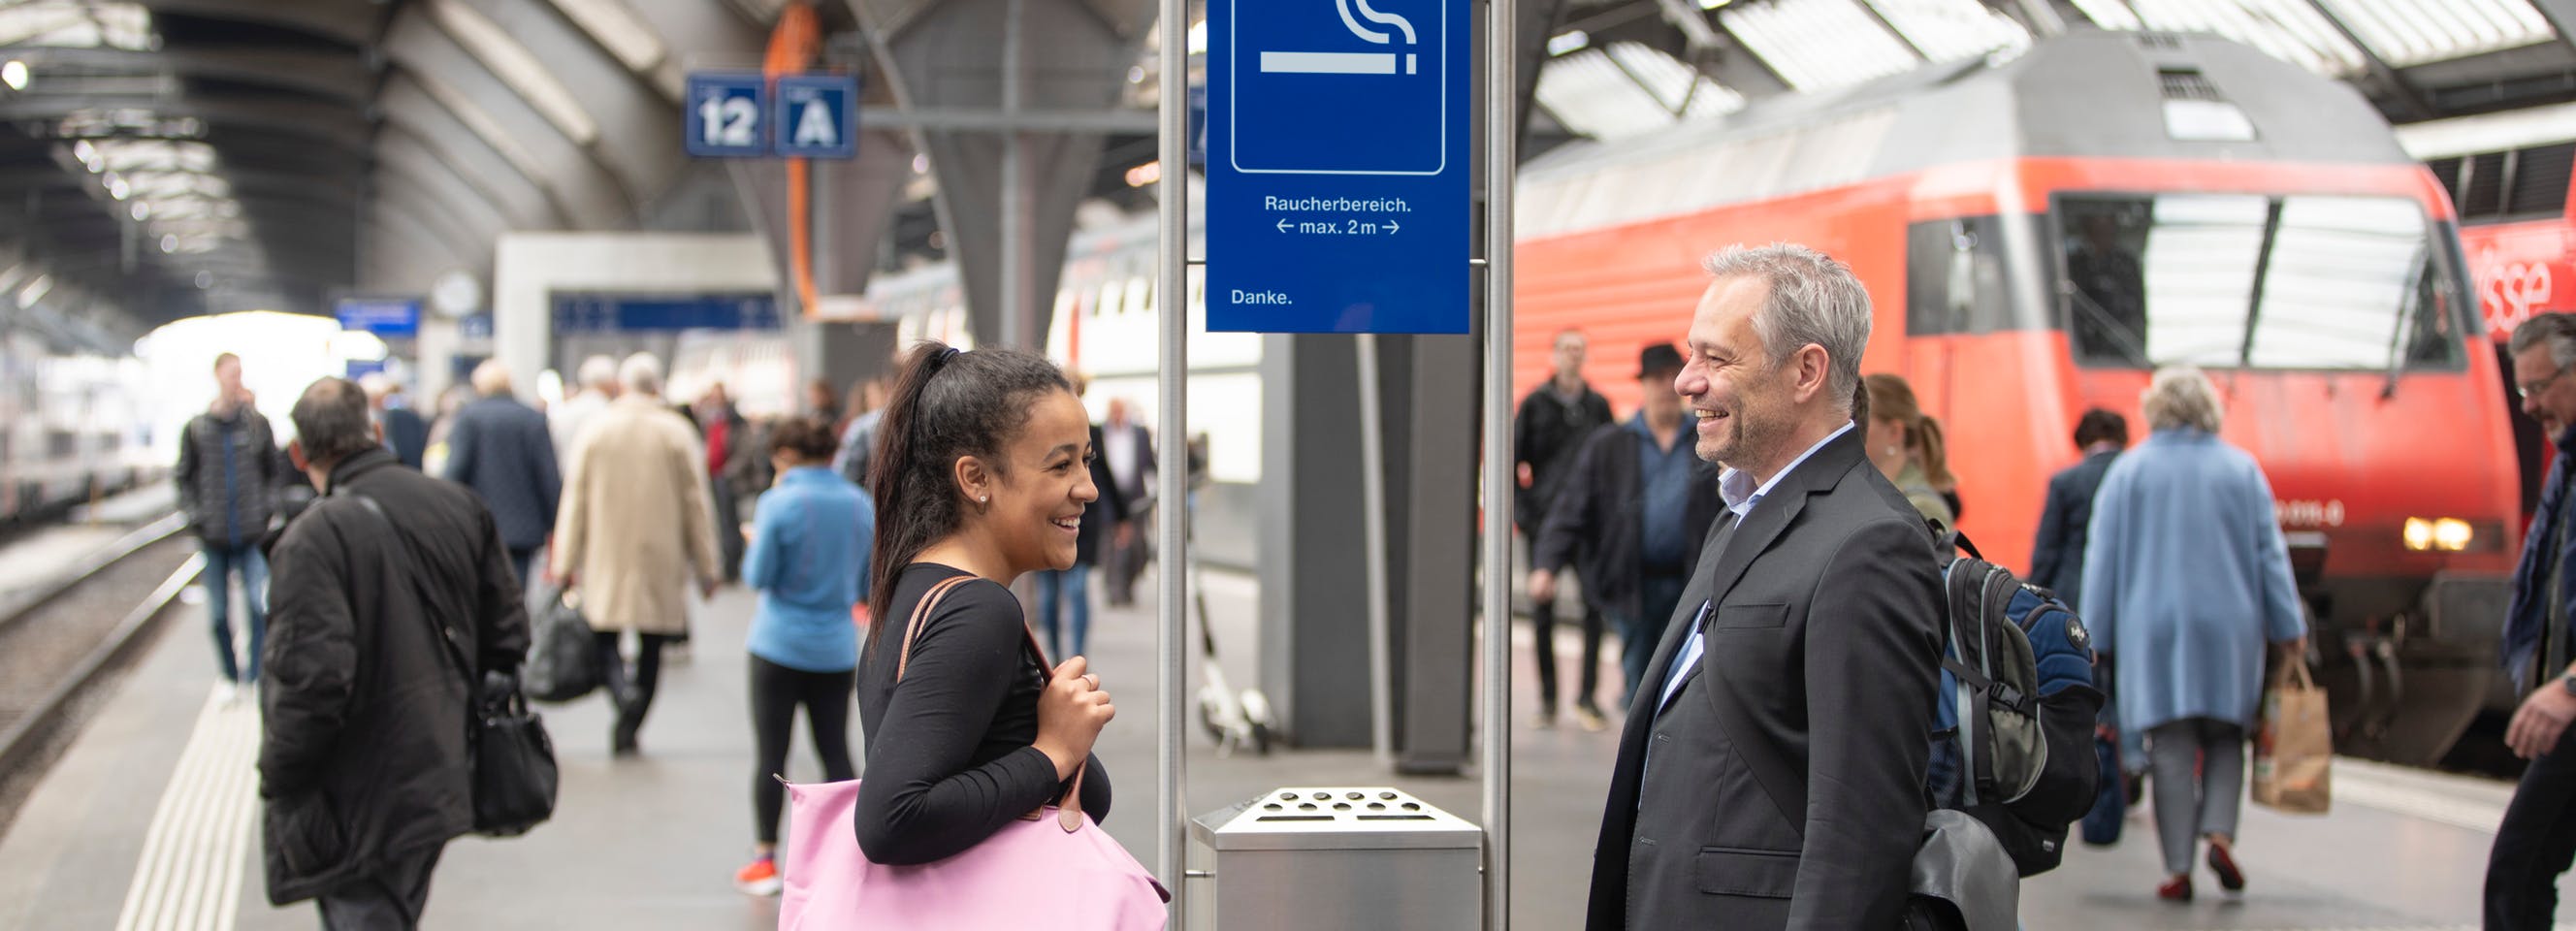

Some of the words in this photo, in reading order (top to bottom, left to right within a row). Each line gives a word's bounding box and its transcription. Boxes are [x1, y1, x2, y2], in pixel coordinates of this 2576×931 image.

[698, 96, 757, 145] 12
[793, 98, 838, 146] A
[1265, 196, 1411, 212] Raucherbereich.
[1300, 222, 1342, 234] max.
[1232, 289, 1293, 305] Danke.
